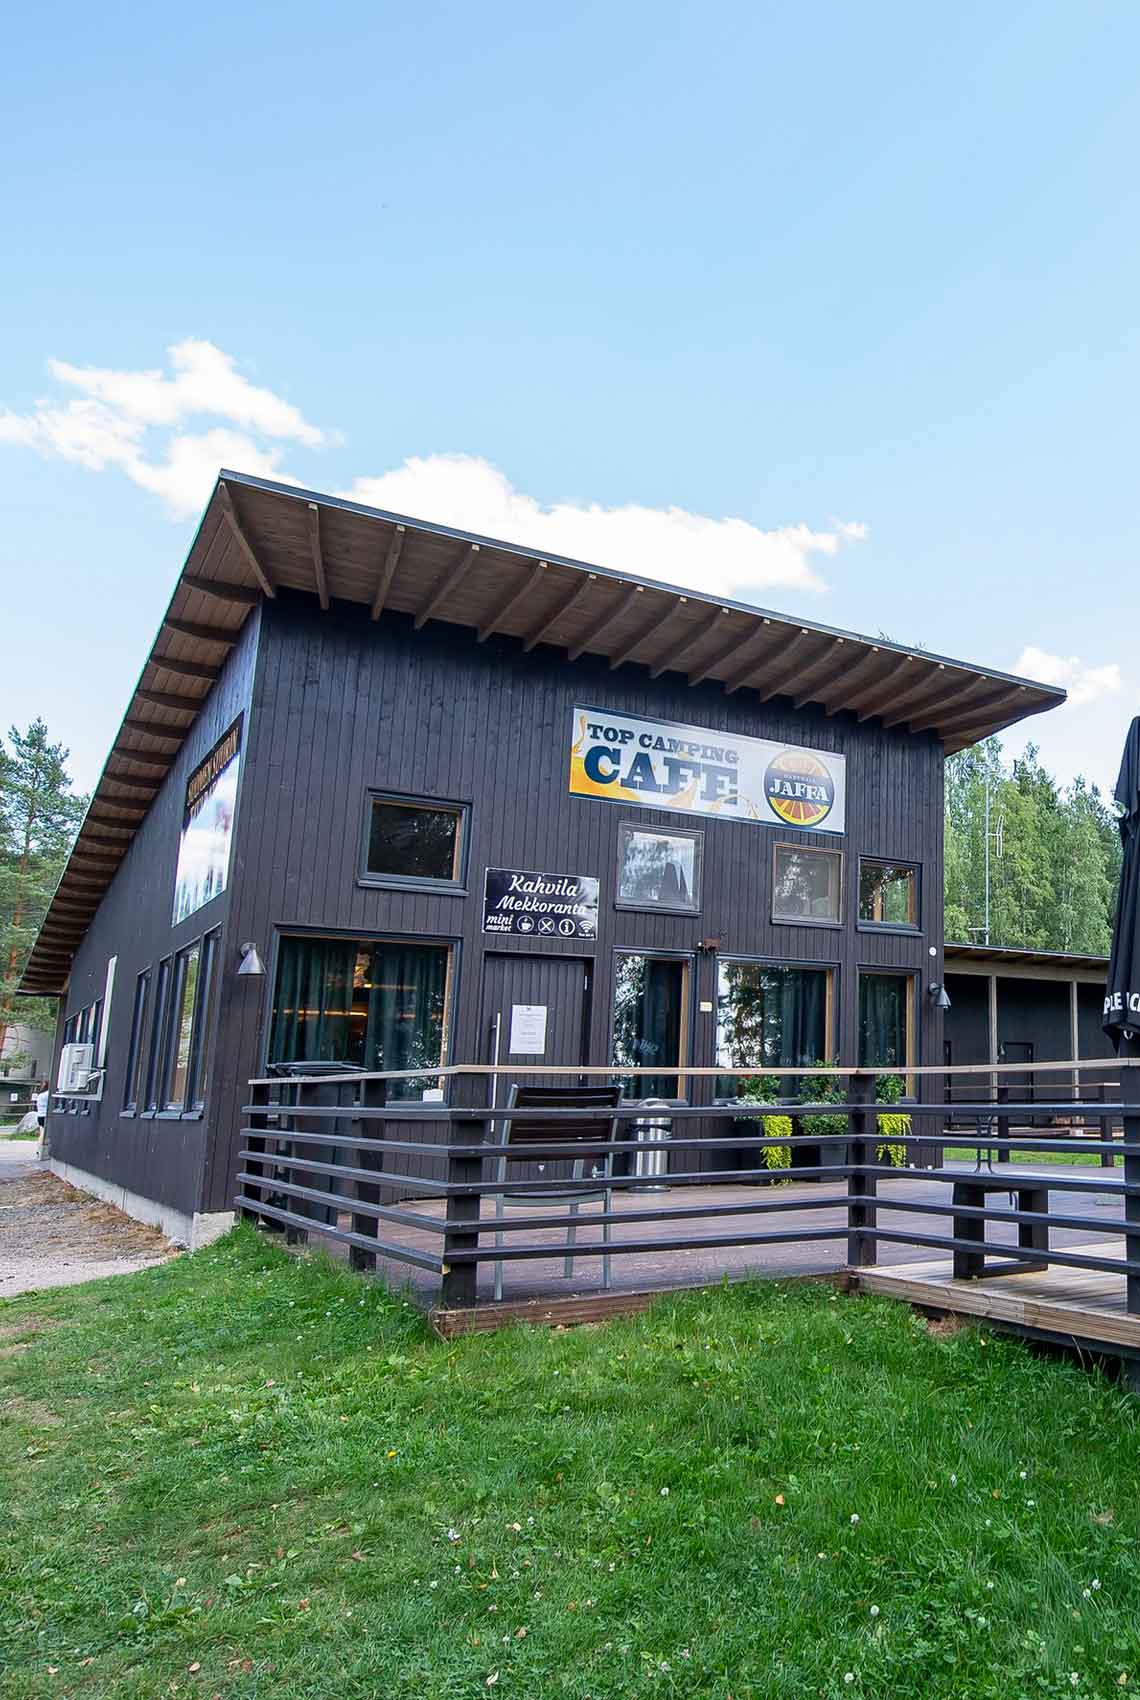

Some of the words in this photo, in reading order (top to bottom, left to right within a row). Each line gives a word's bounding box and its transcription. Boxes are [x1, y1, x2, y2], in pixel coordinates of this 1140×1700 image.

[587, 723, 634, 744] TOP
[638, 734, 739, 763] CAMPING
[584, 745, 738, 805] CAFE
[769, 778, 829, 802] JAFFA
[509, 875, 577, 897] Kahvila
[496, 895, 587, 915] Mekkoranta
[485, 923, 512, 932] market
[486, 914, 514, 925] mini
